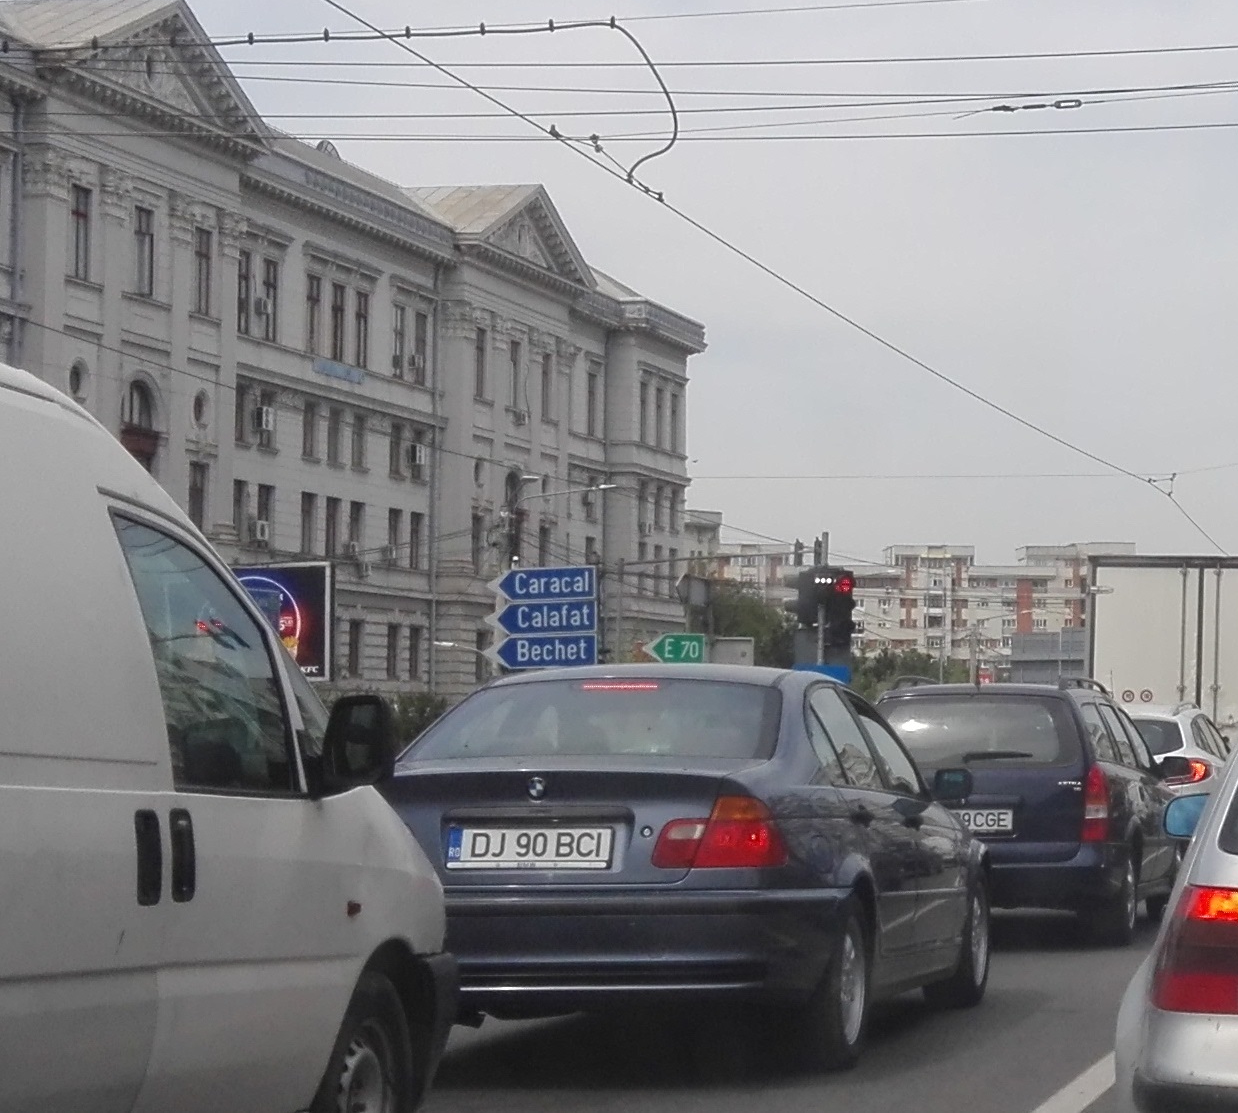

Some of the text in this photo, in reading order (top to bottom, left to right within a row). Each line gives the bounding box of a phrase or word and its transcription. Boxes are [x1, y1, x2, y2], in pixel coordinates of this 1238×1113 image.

[515, 572, 589, 595] Caracal
[517, 605, 590, 629] Calafat
[517, 639, 587, 662] Bechet
[664, 639, 699, 658] E 70
[470, 832, 602, 858] DJ 90 BCI
